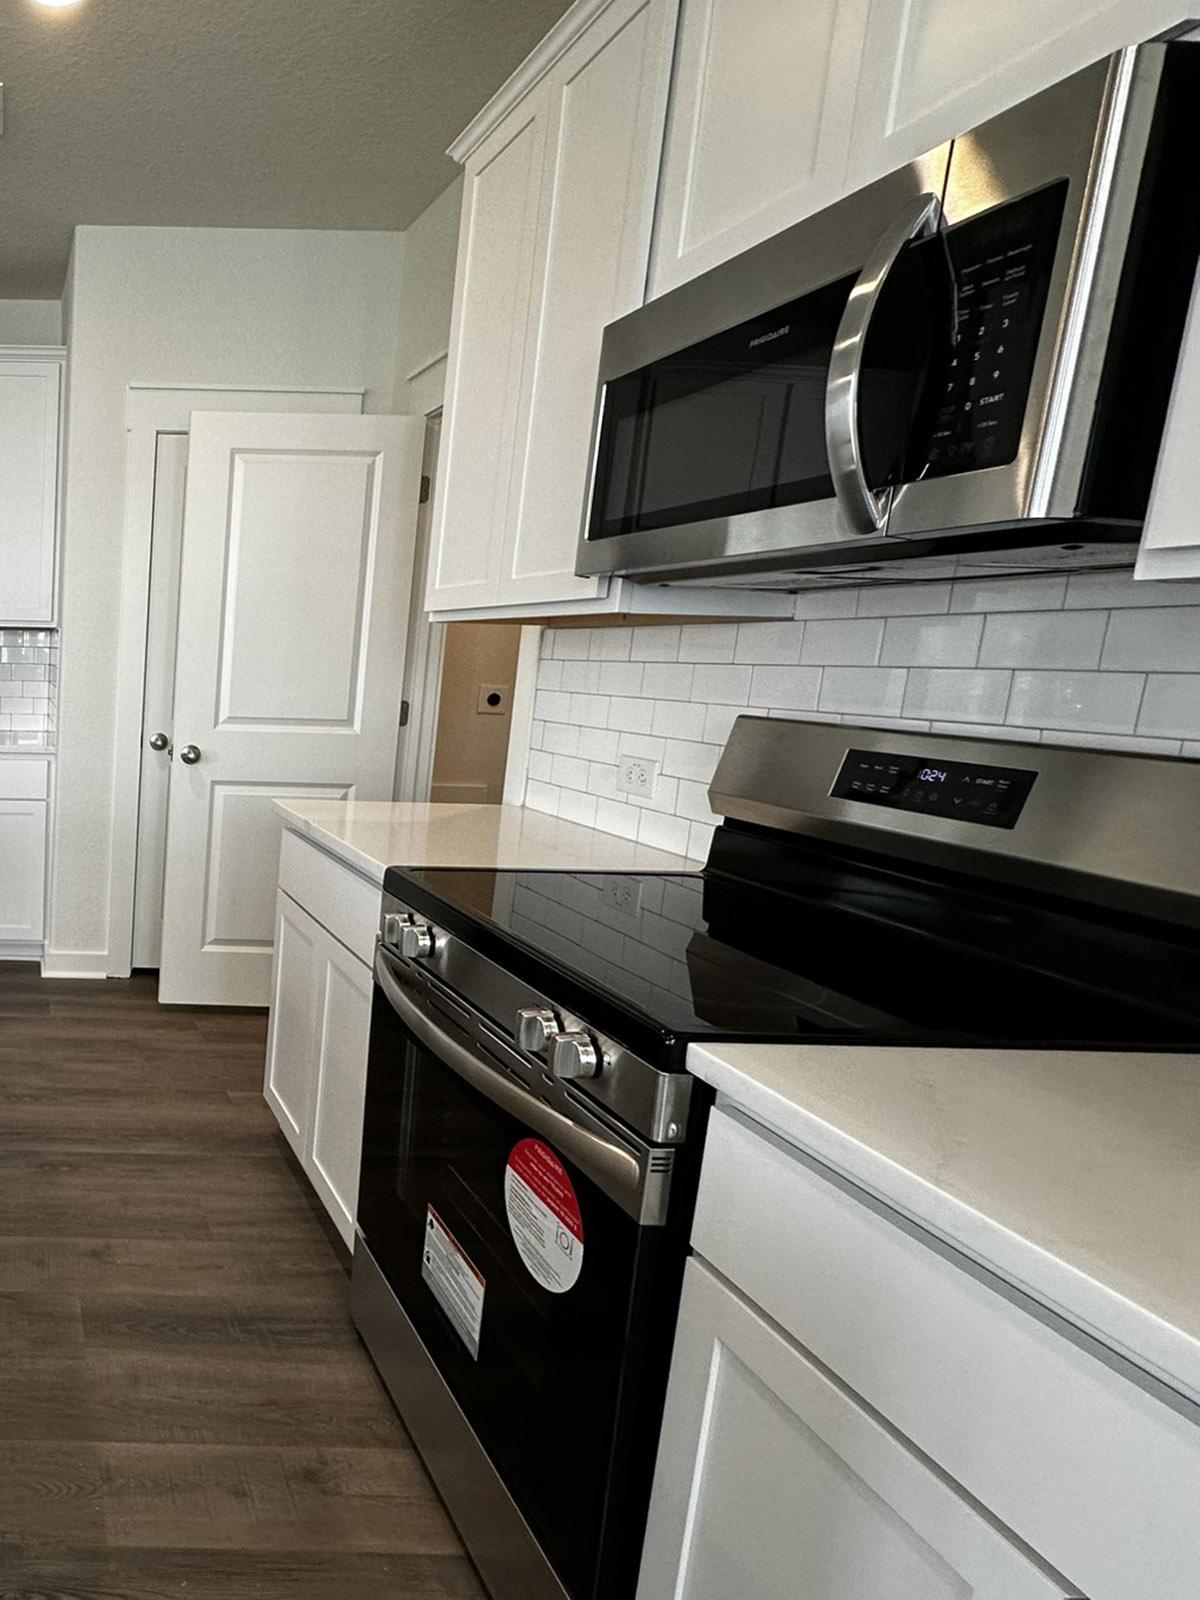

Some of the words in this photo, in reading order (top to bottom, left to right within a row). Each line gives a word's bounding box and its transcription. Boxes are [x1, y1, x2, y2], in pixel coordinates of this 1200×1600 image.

[749, 324, 790, 350] FRIGIDAIRE
[978, 326, 985, 336] 2
[1002, 318, 1009, 328] 3
[951, 358, 958, 367] 4
[973, 351, 980, 361] 5
[997, 344, 1004, 354] 6
[947, 383, 954, 392] 7
[969, 377, 976, 386] 8
[993, 370, 1000, 379] 9
[979, 393, 1005, 406] START
